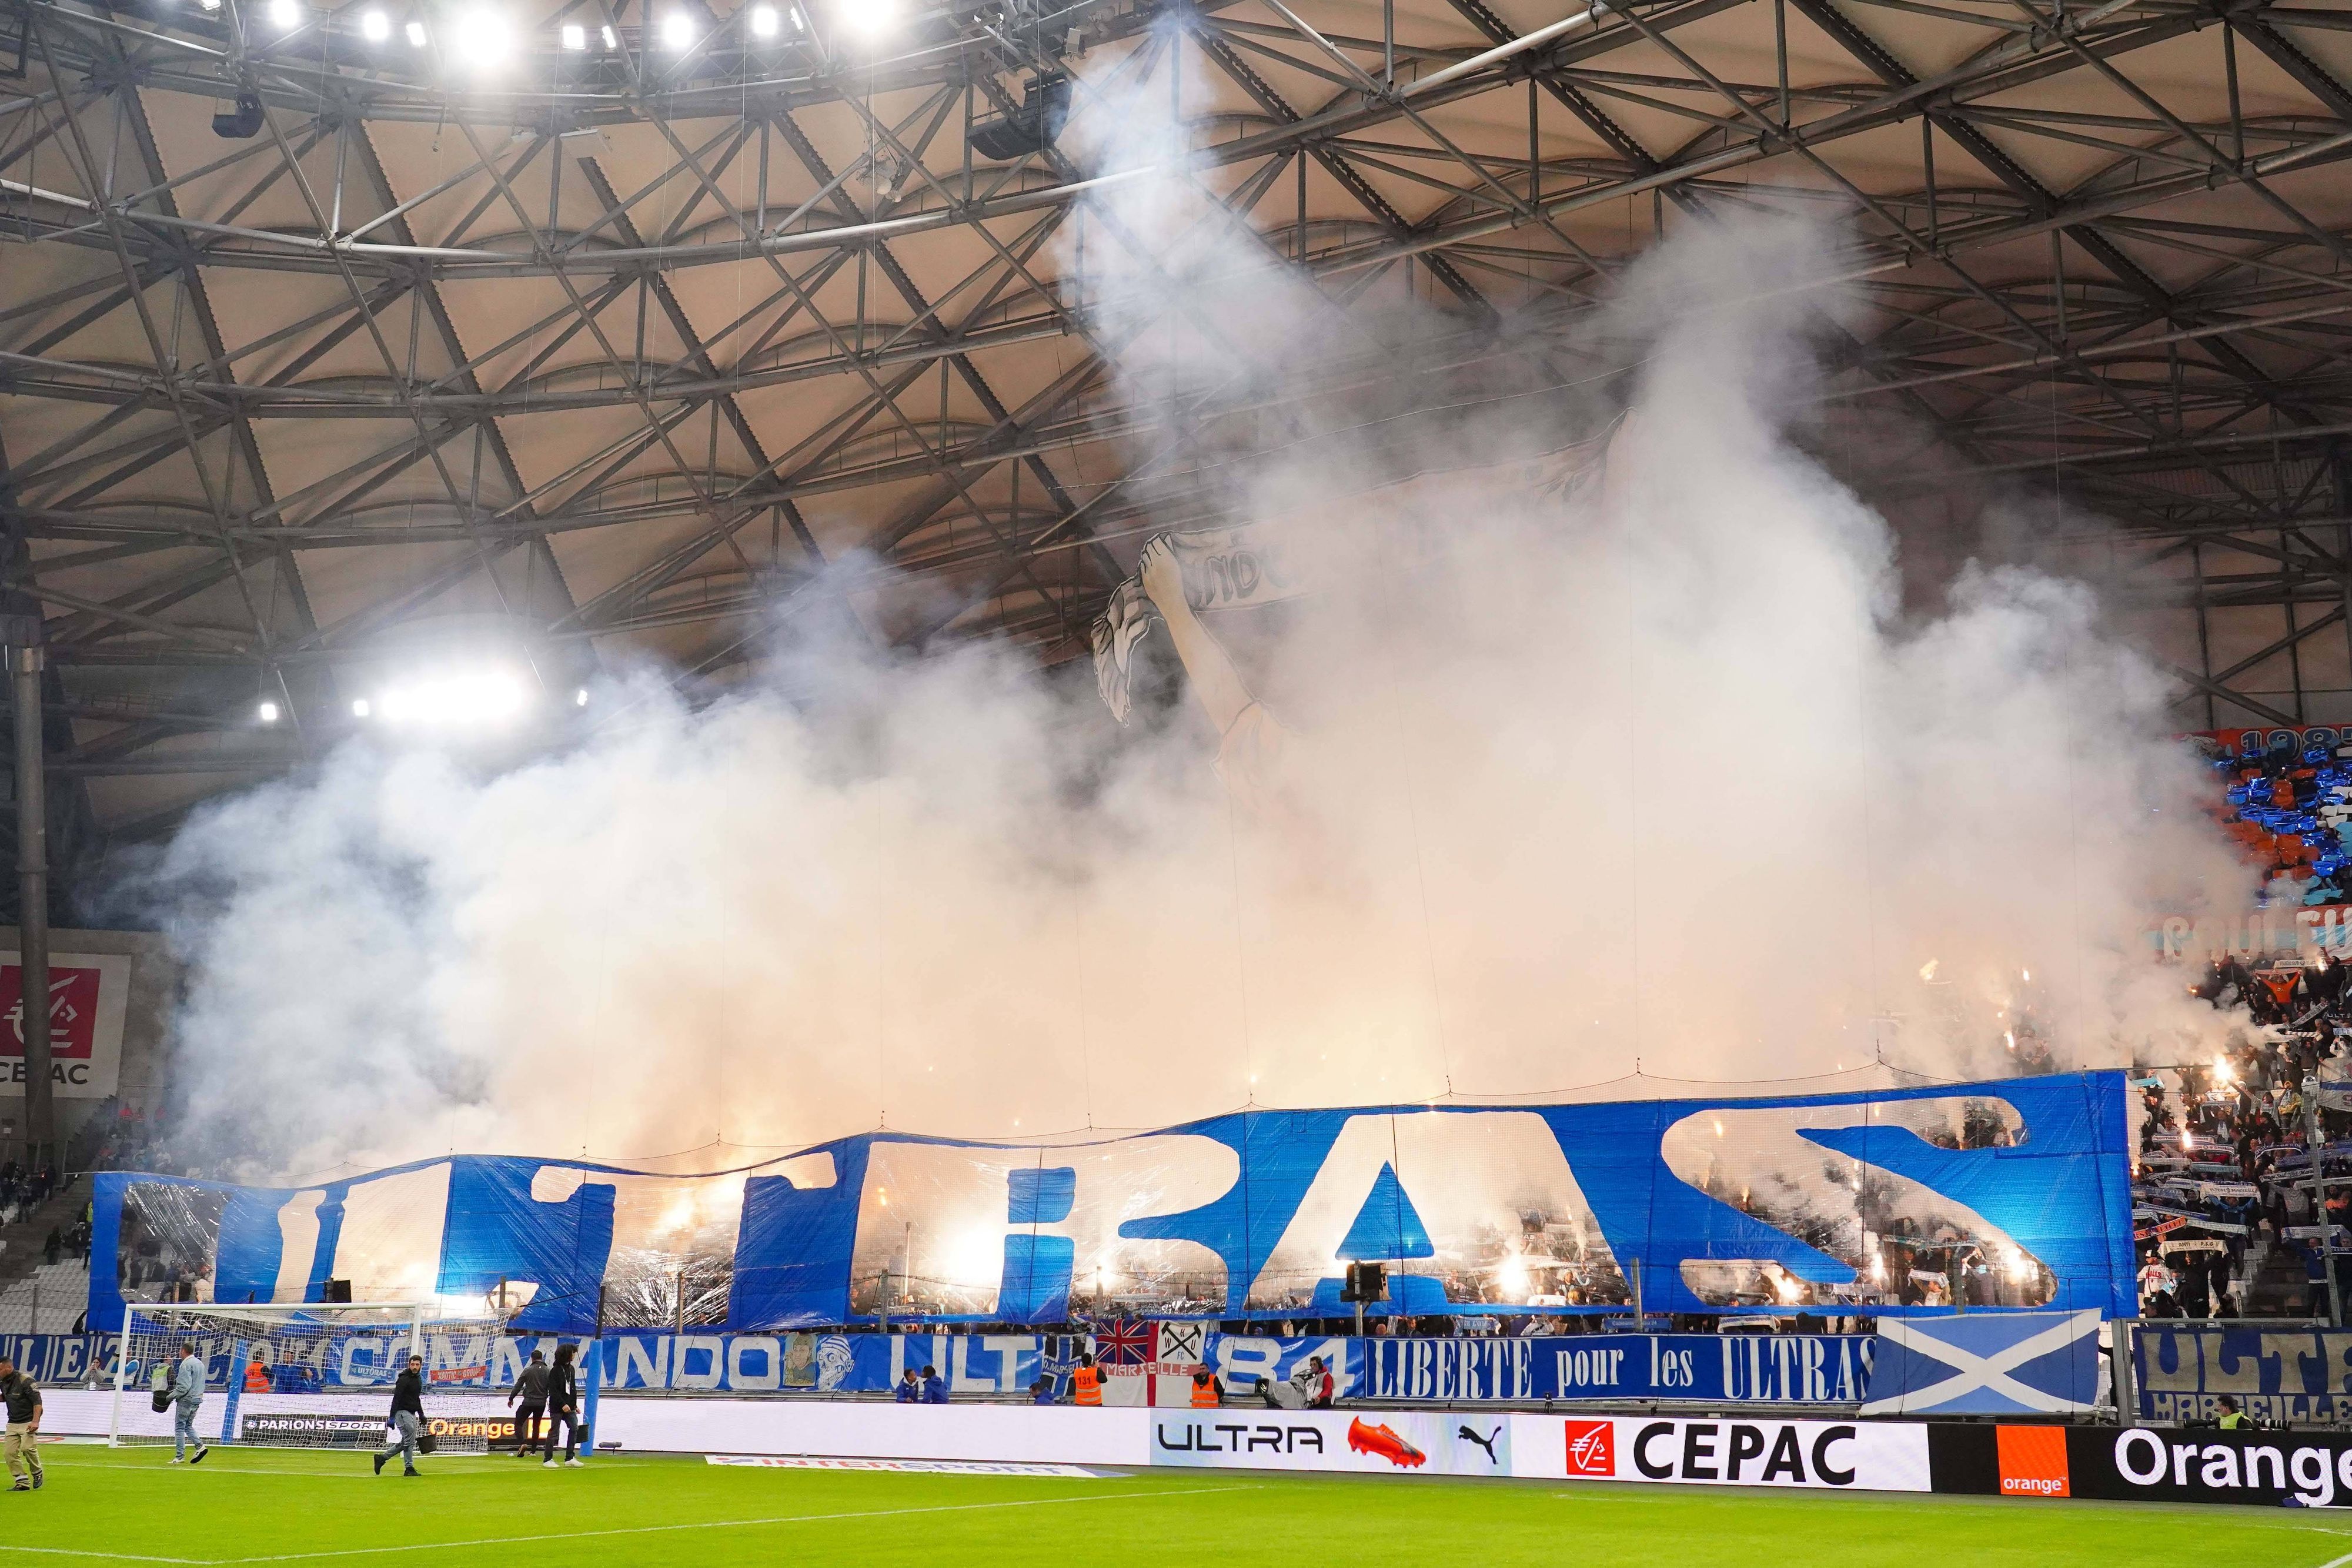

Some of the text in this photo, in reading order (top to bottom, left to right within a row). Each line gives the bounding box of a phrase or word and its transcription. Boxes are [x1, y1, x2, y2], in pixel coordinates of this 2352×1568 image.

[1177, 1351, 1184, 1360] FC
[1106, 1361, 1189, 1377] MARSEILLE
[1374, 1339, 1532, 1399] LIBERTE
[1556, 1349, 1624, 1398] pour
[1649, 1336, 1693, 1388] les
[1078, 1376, 1091, 1385] 131
[259, 1419, 383, 1431] PARIONS SPORT
[429, 1419, 516, 1440] Orange
[1158, 1423, 1323, 1454] ULTRA
[1633, 1422, 1856, 1486] CEPAC
[761, 1458, 1063, 1475] INTERSPORT
[2003, 1477, 2062, 1495] orange
